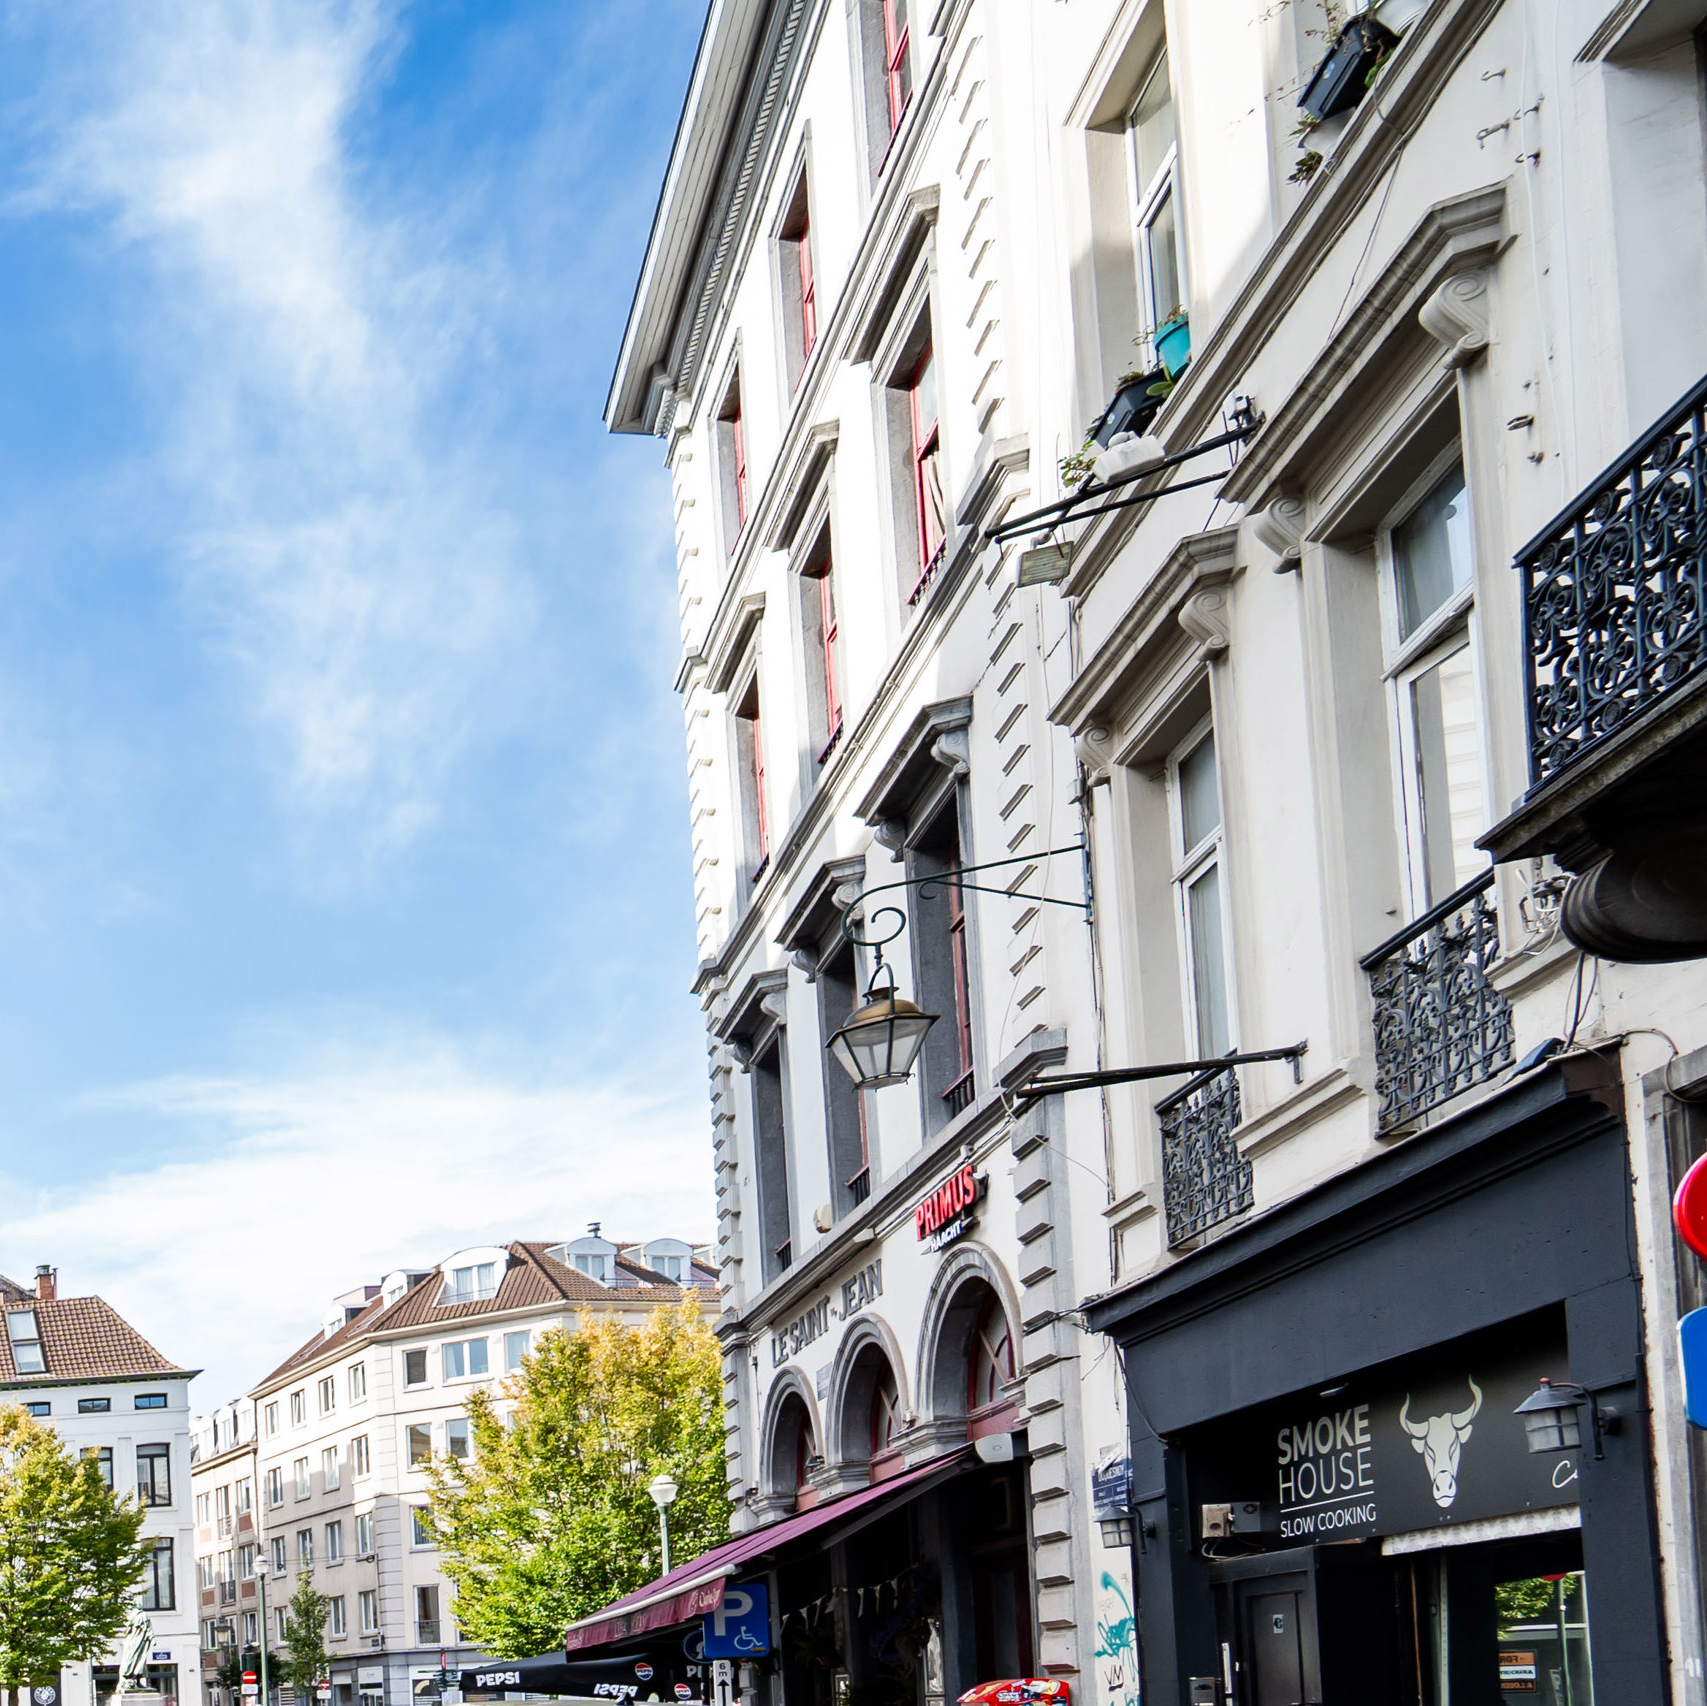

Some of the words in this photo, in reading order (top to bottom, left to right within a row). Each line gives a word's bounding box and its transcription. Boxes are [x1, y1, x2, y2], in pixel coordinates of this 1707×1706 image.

[915, 1164, 975, 1242] PRIMUS
[930, 1219, 963, 1253] HAACHT
[771, 1327, 790, 1369] LE
[1277, 1404, 1371, 1465] SMOKE
[1279, 1446, 1374, 1504] HOUSE
[1280, 1515, 1315, 1538] SLOW
[1317, 1503, 1376, 1531] COOKING
[714, 1591, 753, 1636] P
[476, 1671, 520, 1688] PEPSI
[718, 1662, 727, 1671] 6
